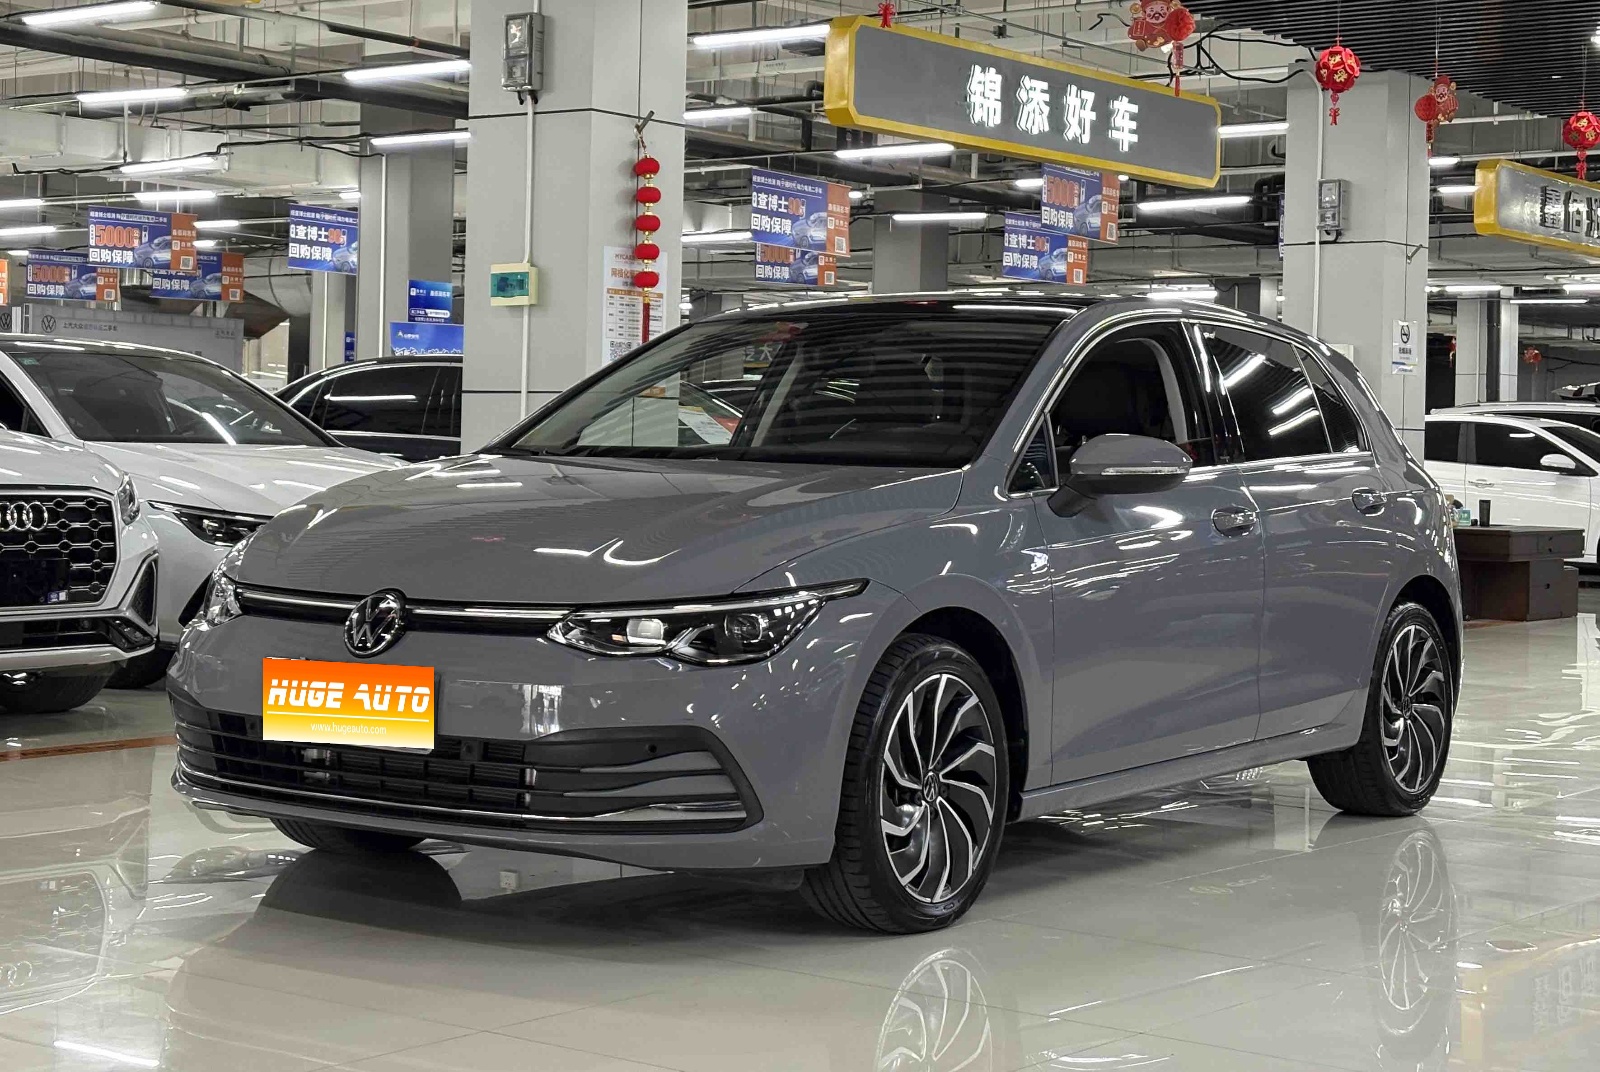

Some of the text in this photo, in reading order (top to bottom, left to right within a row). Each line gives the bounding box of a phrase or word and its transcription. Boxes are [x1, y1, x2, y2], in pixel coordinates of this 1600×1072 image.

[967, 64, 1139, 152] 锦添好车
[751, 213, 792, 236] 回购保障
[1042, 206, 1073, 230] 回购保障
[89, 248, 134, 264] 回购保障
[289, 243, 332, 261] 回购保障
[1003, 252, 1038, 270] 回购保障
[756, 265, 789, 279] 回购保障
[27, 283, 64, 295] 回购保障
[152, 278, 189, 290] 回购保障
